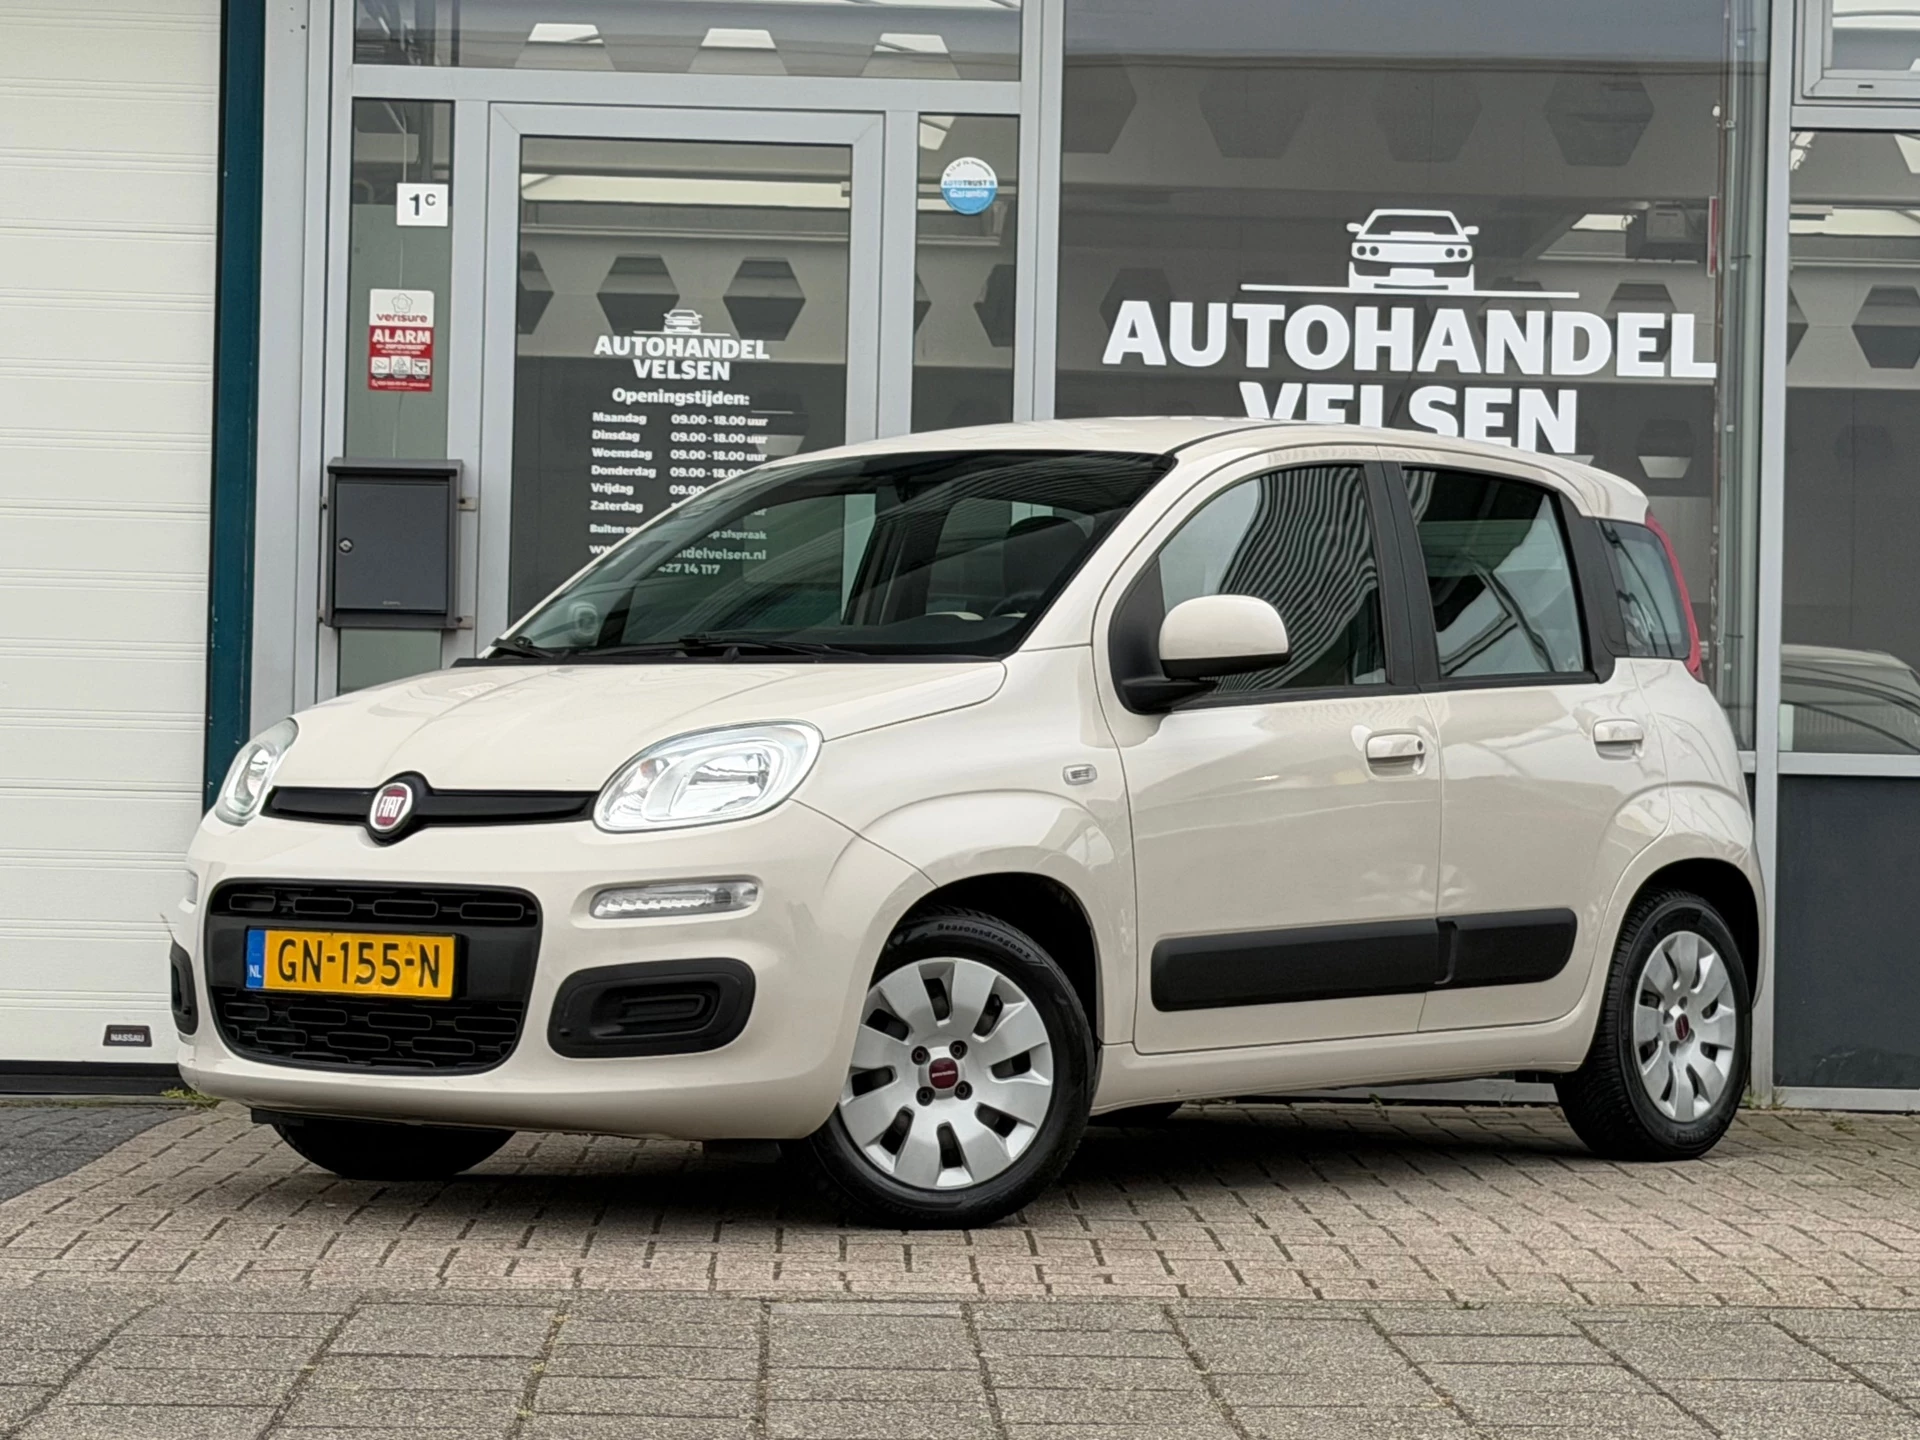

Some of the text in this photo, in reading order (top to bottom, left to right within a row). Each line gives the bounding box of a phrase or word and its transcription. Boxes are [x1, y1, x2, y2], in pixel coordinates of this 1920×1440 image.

[376, 313, 428, 323] verisure
[372, 328, 431, 344] ALARM
[1102, 299, 1717, 378] AUTOHANDEL
[593, 335, 770, 360] AUTOHANDEL
[633, 359, 730, 381] VELSEN
[612, 387, 750, 407] Openingstijden:
[592, 412, 647, 425] Maandag
[747, 418, 768, 427] uur
[592, 430, 640, 443] Dinsdag
[747, 436, 768, 444] uur
[591, 447, 652, 460] Woensdag
[746, 453, 767, 462] uur
[591, 465, 657, 478] Donderdag
[591, 483, 634, 496] Vrijdag
[590, 500, 643, 513] Zaterdag
[589, 524, 624, 534] Buiten
[721, 529, 767, 540] afspraak
[684, 563, 699, 574] 14
[701, 564, 720, 575] 117
[377, 796, 405, 817] FIAT
[277, 938, 440, 988] GN-155-N
[249, 964, 262, 978] NL
